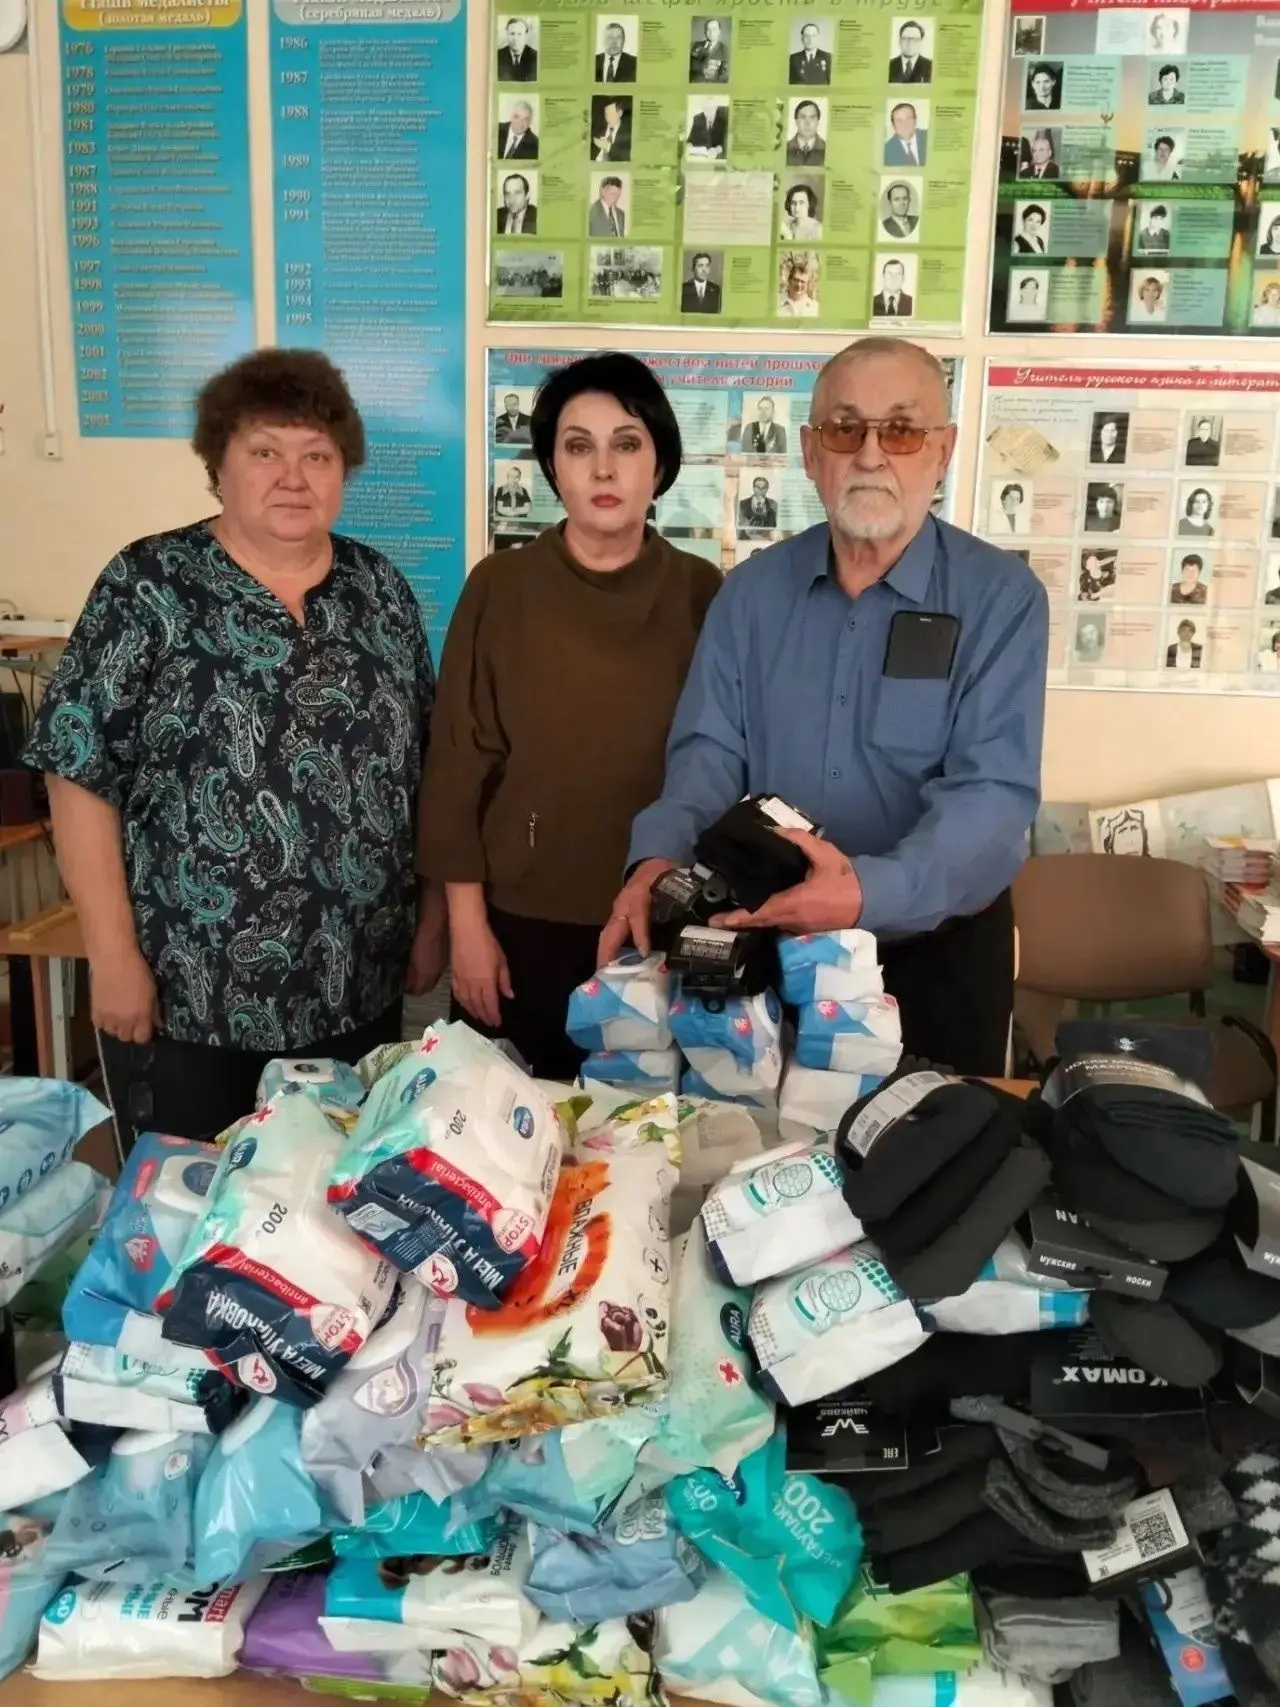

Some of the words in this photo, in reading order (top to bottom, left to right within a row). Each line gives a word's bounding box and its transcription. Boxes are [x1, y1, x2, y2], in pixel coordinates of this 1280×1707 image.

[281, 71, 308, 84] 1987
[763, 358, 827, 373] прошло
[261, 1202, 288, 1235] 200
[503, 1214, 536, 1253] STOP
[238, 1258, 309, 1305] antibacterial
[319, 1310, 353, 1350] STOP
[731, 1307, 743, 1347] AURA
[279, 1341, 327, 1381] МЕГА
[782, 1473, 836, 1536] 200
